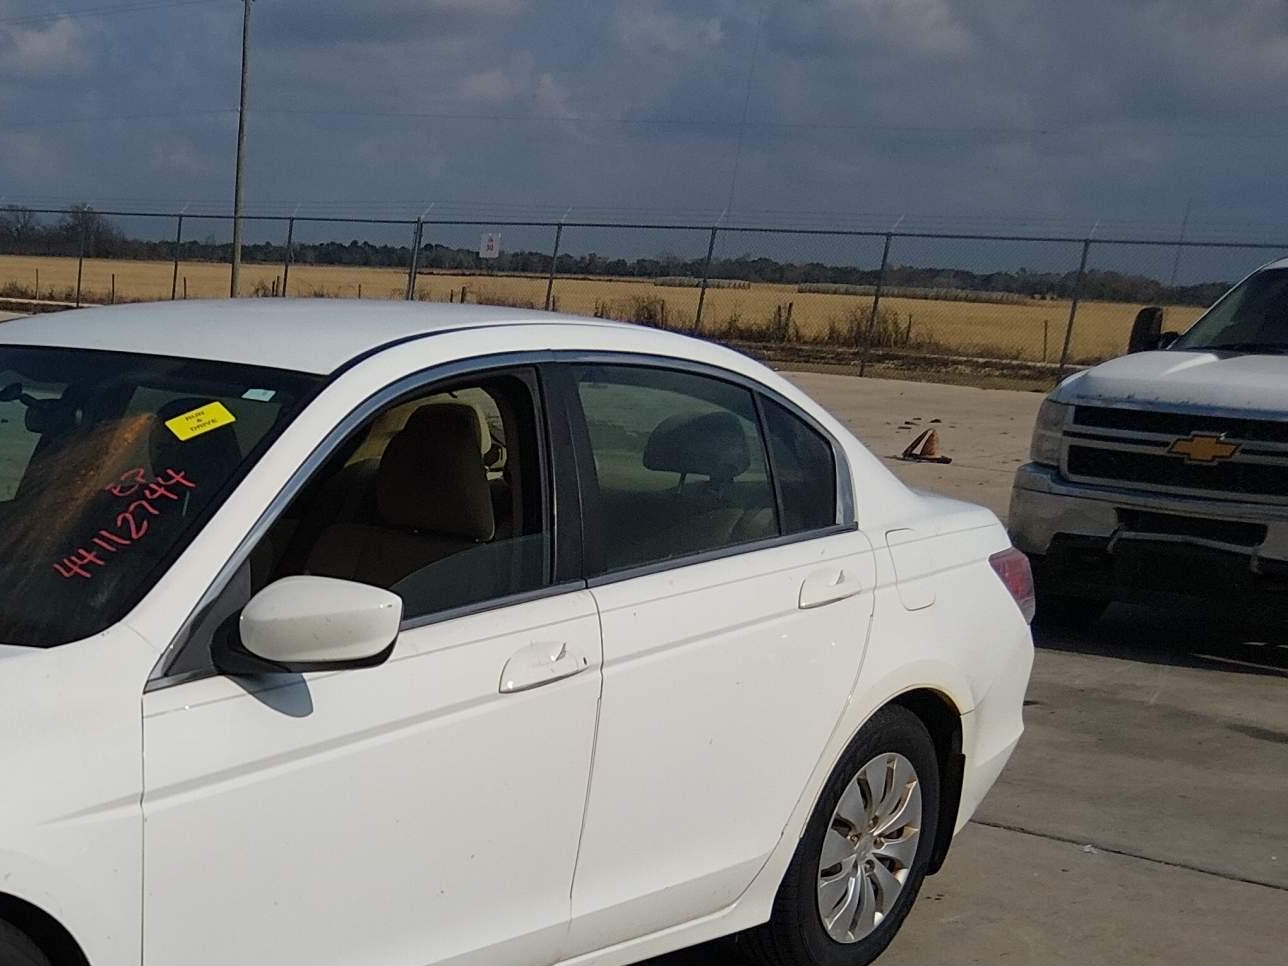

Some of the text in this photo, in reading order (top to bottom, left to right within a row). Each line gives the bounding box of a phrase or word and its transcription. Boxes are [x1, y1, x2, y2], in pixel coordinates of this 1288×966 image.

[185, 411, 205, 421] RUN
[190, 418, 218, 432] DRIVE
[52, 468, 197, 578] 44112744
